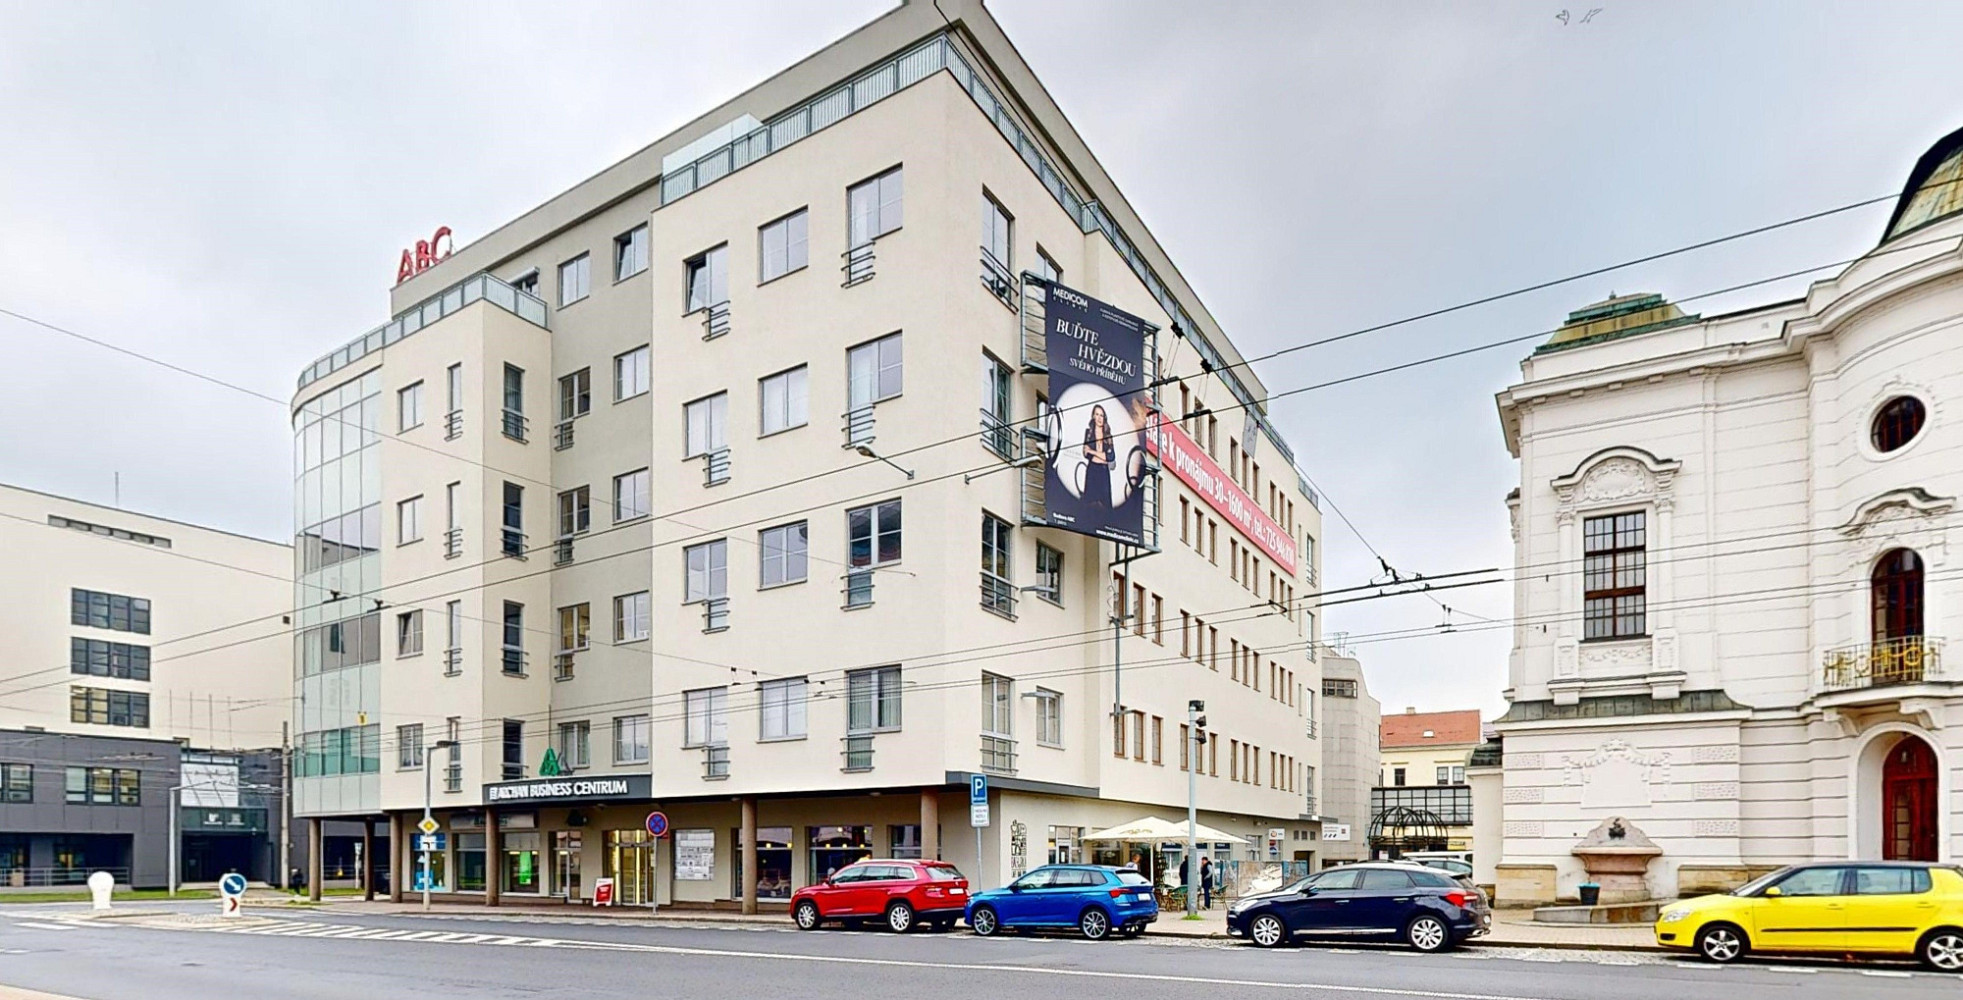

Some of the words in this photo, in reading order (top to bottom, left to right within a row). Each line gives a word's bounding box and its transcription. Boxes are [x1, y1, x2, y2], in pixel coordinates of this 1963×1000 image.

[397, 226, 452, 286] ABC
[1053, 286, 1088, 308] MEDICOM
[1056, 318, 1099, 346] BUĎTE
[1069, 357, 1095, 374] SVÉHO
[1078, 343, 1137, 377] HVĚZDOU
[1096, 366, 1127, 386] PŘÍBĚHU
[1169, 431, 1175, 461] k
[1176, 445, 1214, 496] pronájmu
[530, 782, 573, 798] BUSINESS
[574, 780, 628, 796] CENTRUM
[974, 778, 983, 795] P
